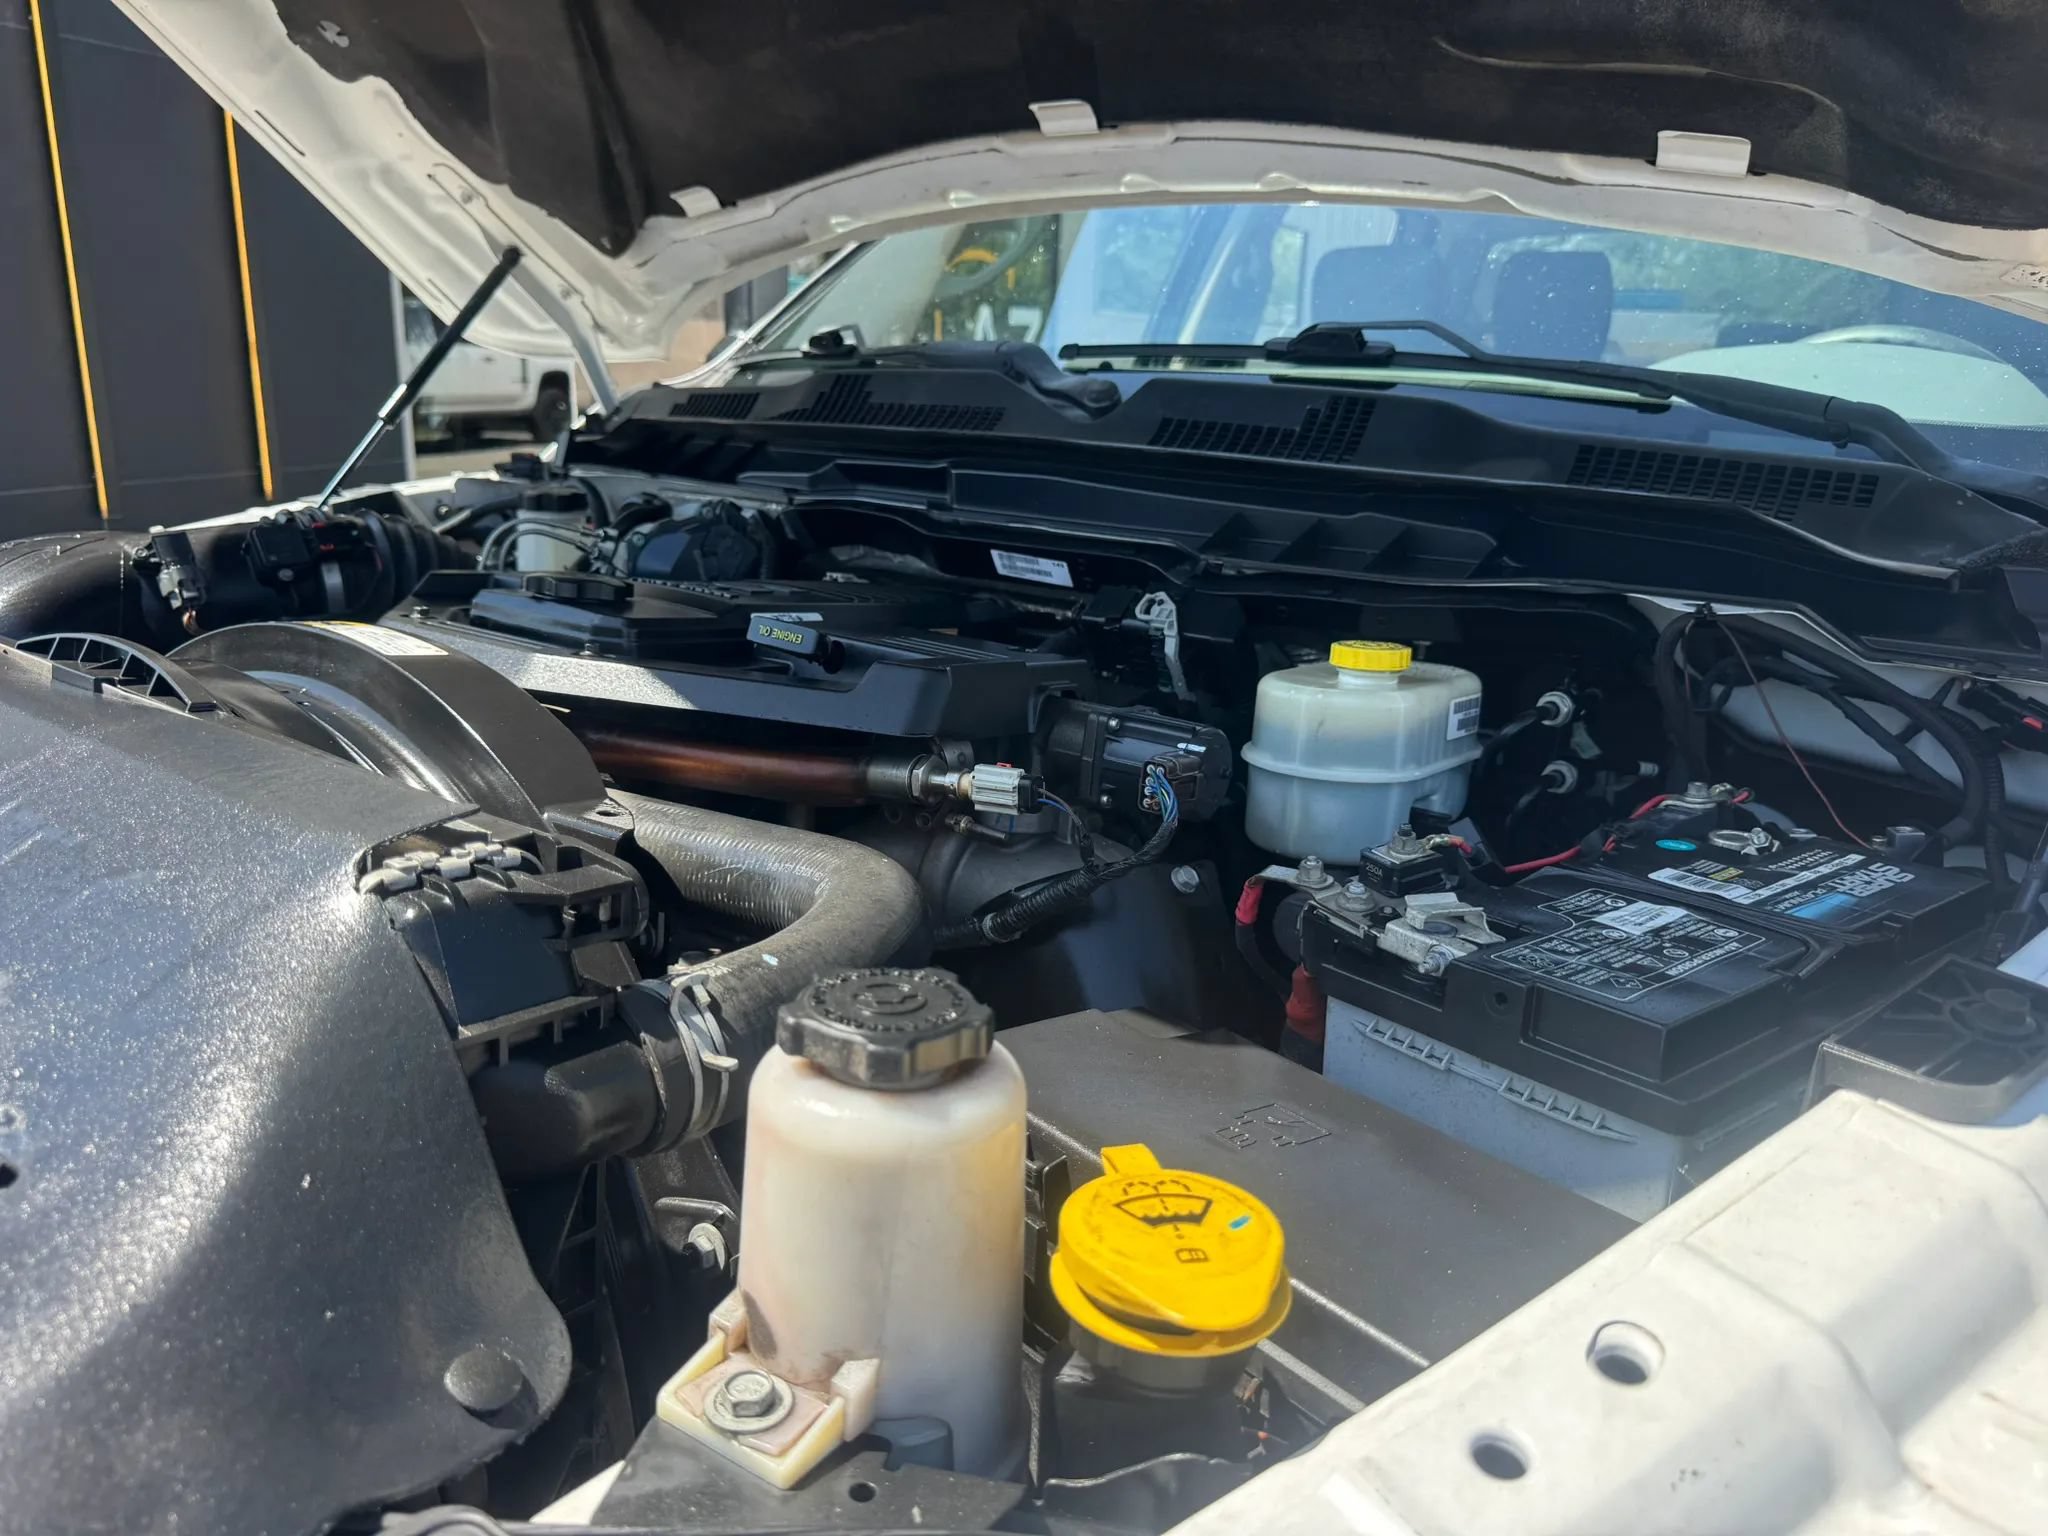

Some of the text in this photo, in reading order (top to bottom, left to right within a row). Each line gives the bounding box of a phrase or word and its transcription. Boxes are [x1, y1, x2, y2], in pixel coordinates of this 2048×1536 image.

[759, 624, 803, 644] ENGINE OIL
[1827, 862, 1901, 892] START
[1845, 871, 1916, 898] SUPER
